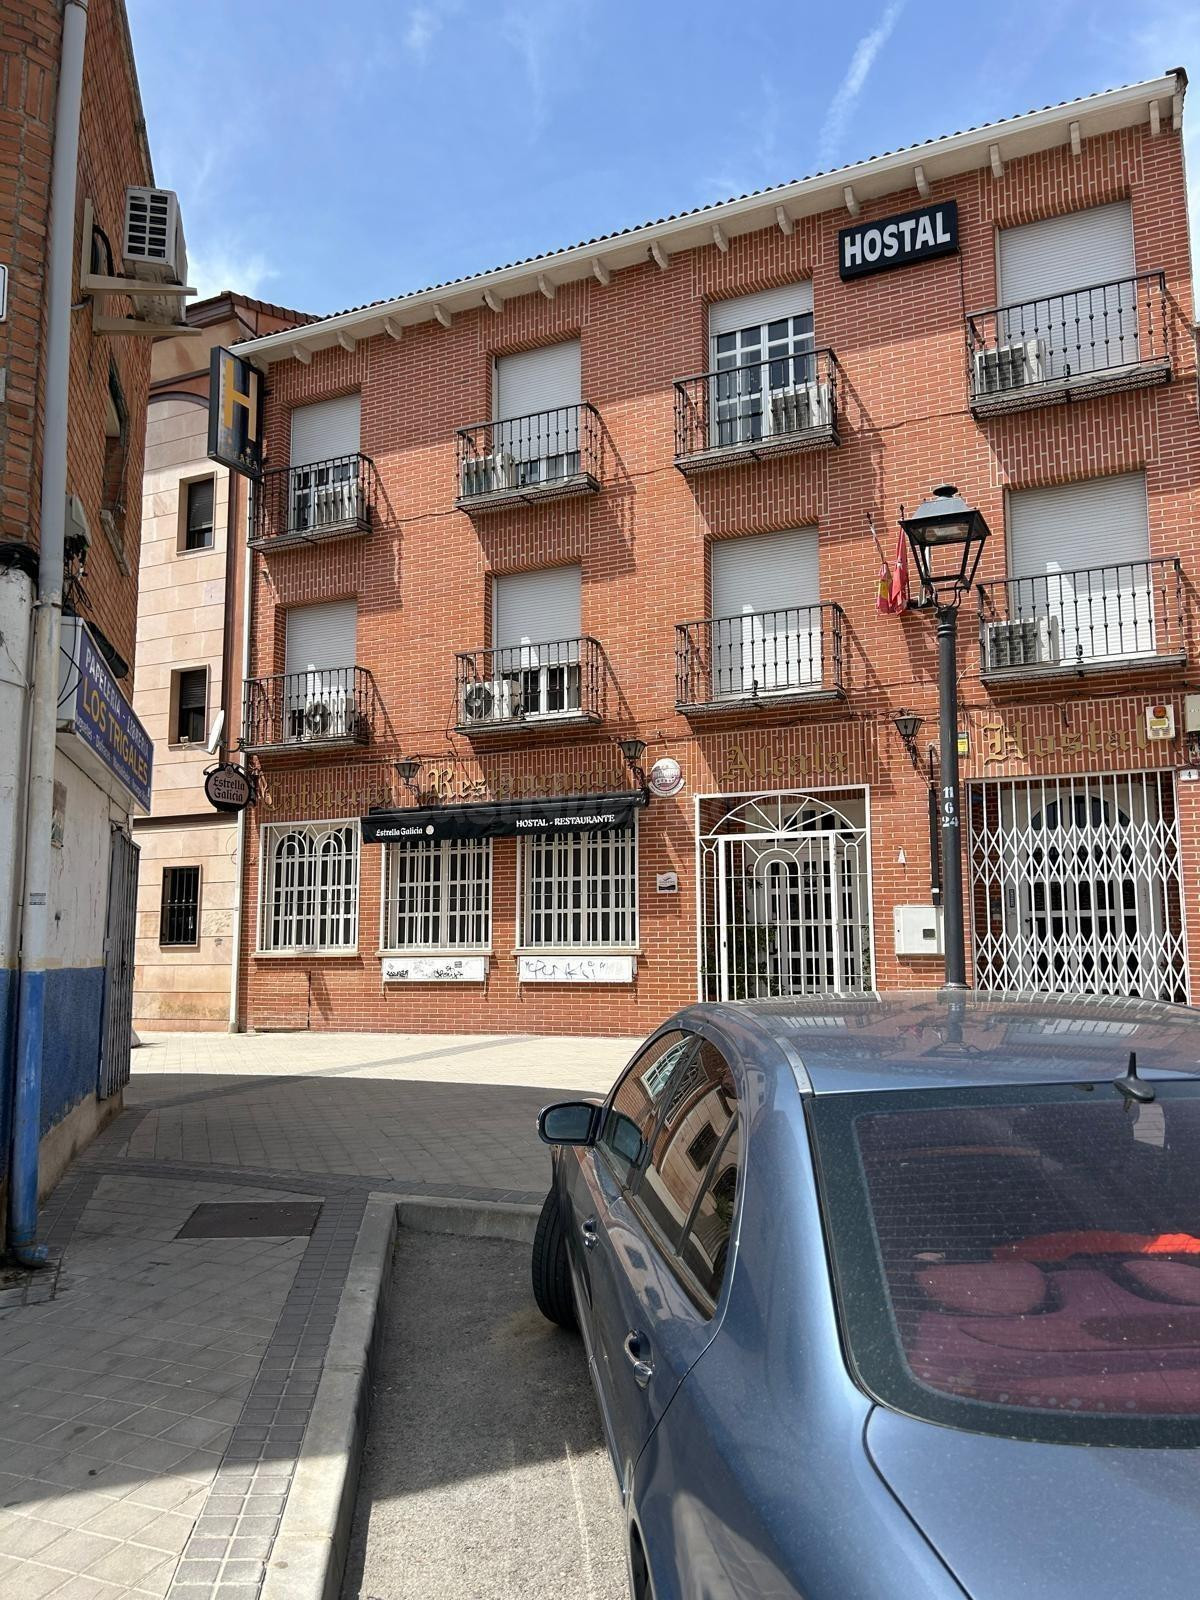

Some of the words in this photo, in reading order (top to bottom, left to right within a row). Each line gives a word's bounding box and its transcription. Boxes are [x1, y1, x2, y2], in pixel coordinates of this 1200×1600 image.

[844, 211, 951, 268] HOSTAL
[223, 358, 259, 443] H
[85, 646, 121, 719] PAPELERIA
[82, 676, 107, 733] LOS
[108, 710, 148, 787] TRIGALES
[984, 712, 1149, 765] Hostal
[213, 776, 245, 791] Estrella
[213, 787, 243, 802] Galicia
[944, 802, 954, 814] 6
[515, 818, 549, 828] HOSTAL
[554, 814, 616, 826] RESTAURANTE
[941, 816, 960, 828] 24
[375, 828, 400, 837] Estrella
[400, 826, 423, 836] Galicia
